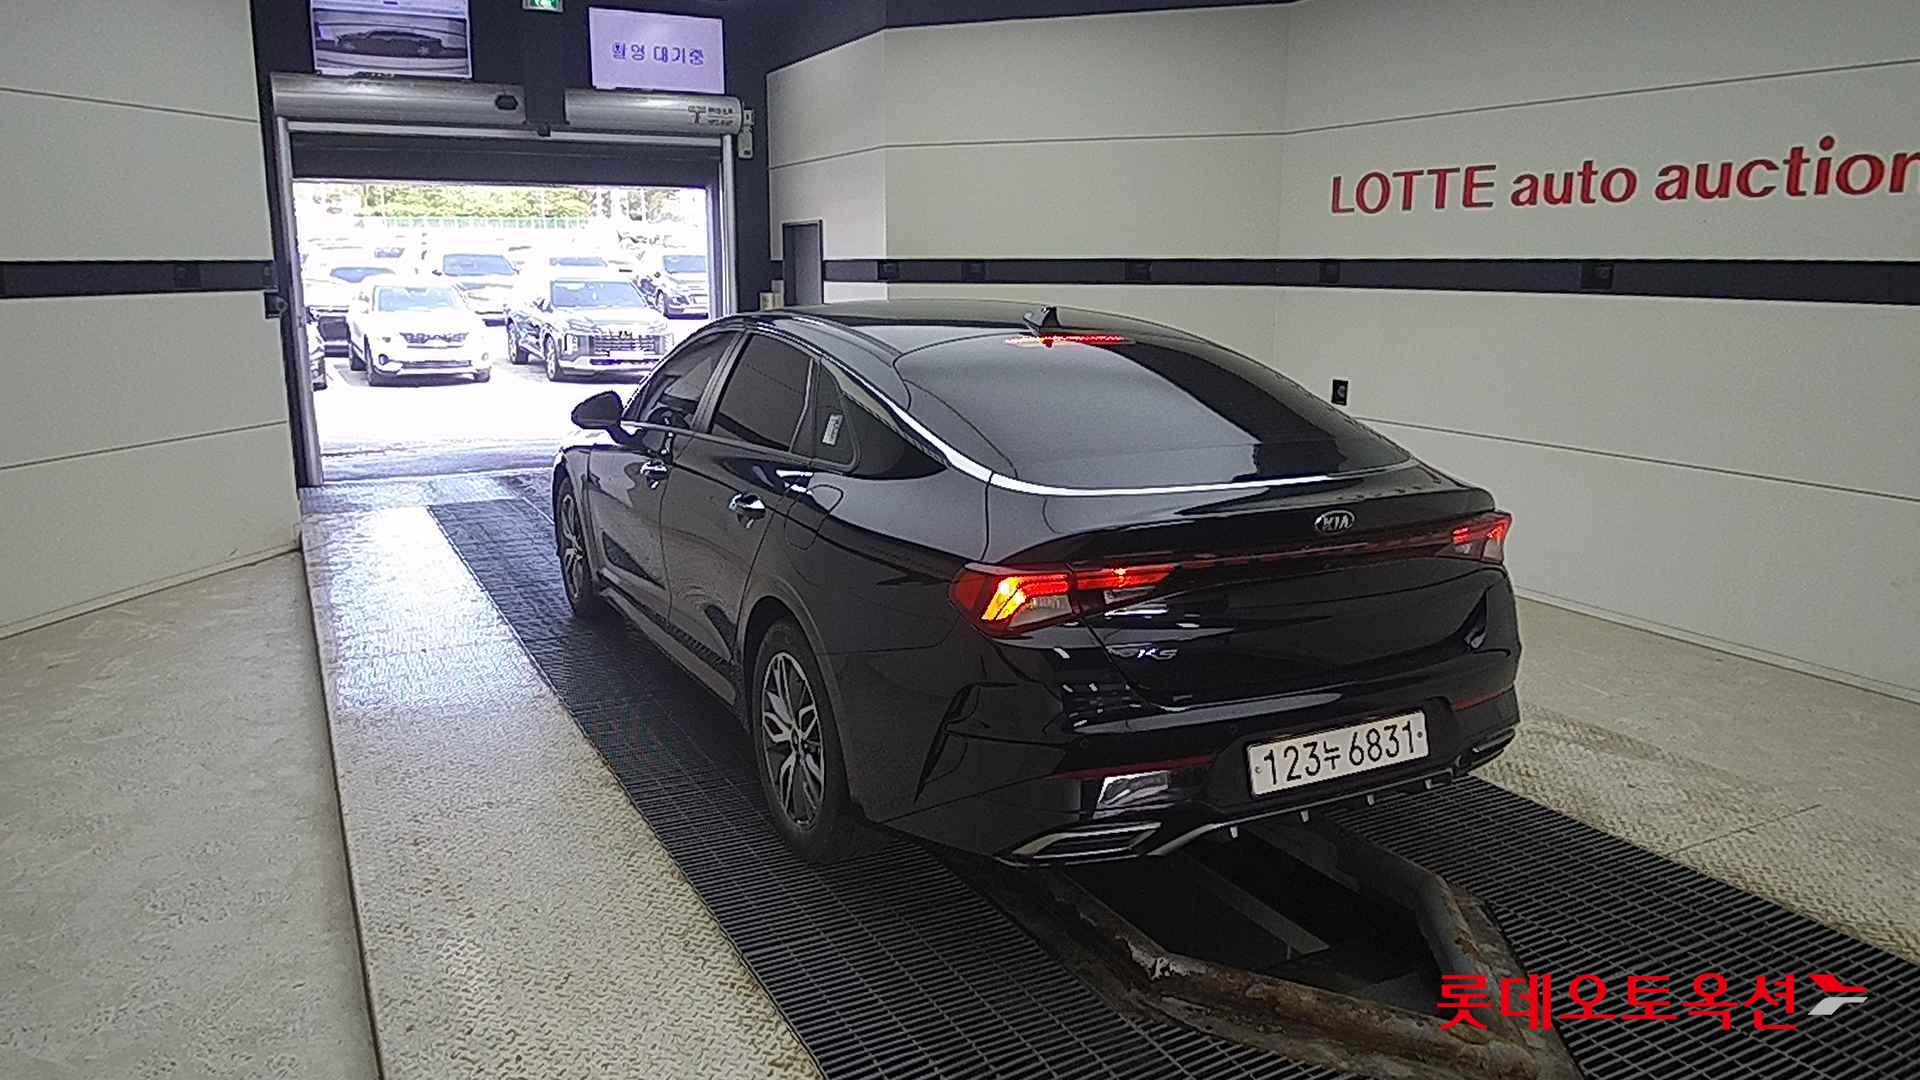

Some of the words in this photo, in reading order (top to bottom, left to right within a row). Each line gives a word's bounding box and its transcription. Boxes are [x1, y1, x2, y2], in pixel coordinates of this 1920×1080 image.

[653, 45, 704, 65] 대기중
[1331, 164, 1497, 214] LOTTE
[1511, 160, 1637, 206] auto
[1263, 740, 1341, 785] 123누
[1349, 719, 1415, 766] 6831
